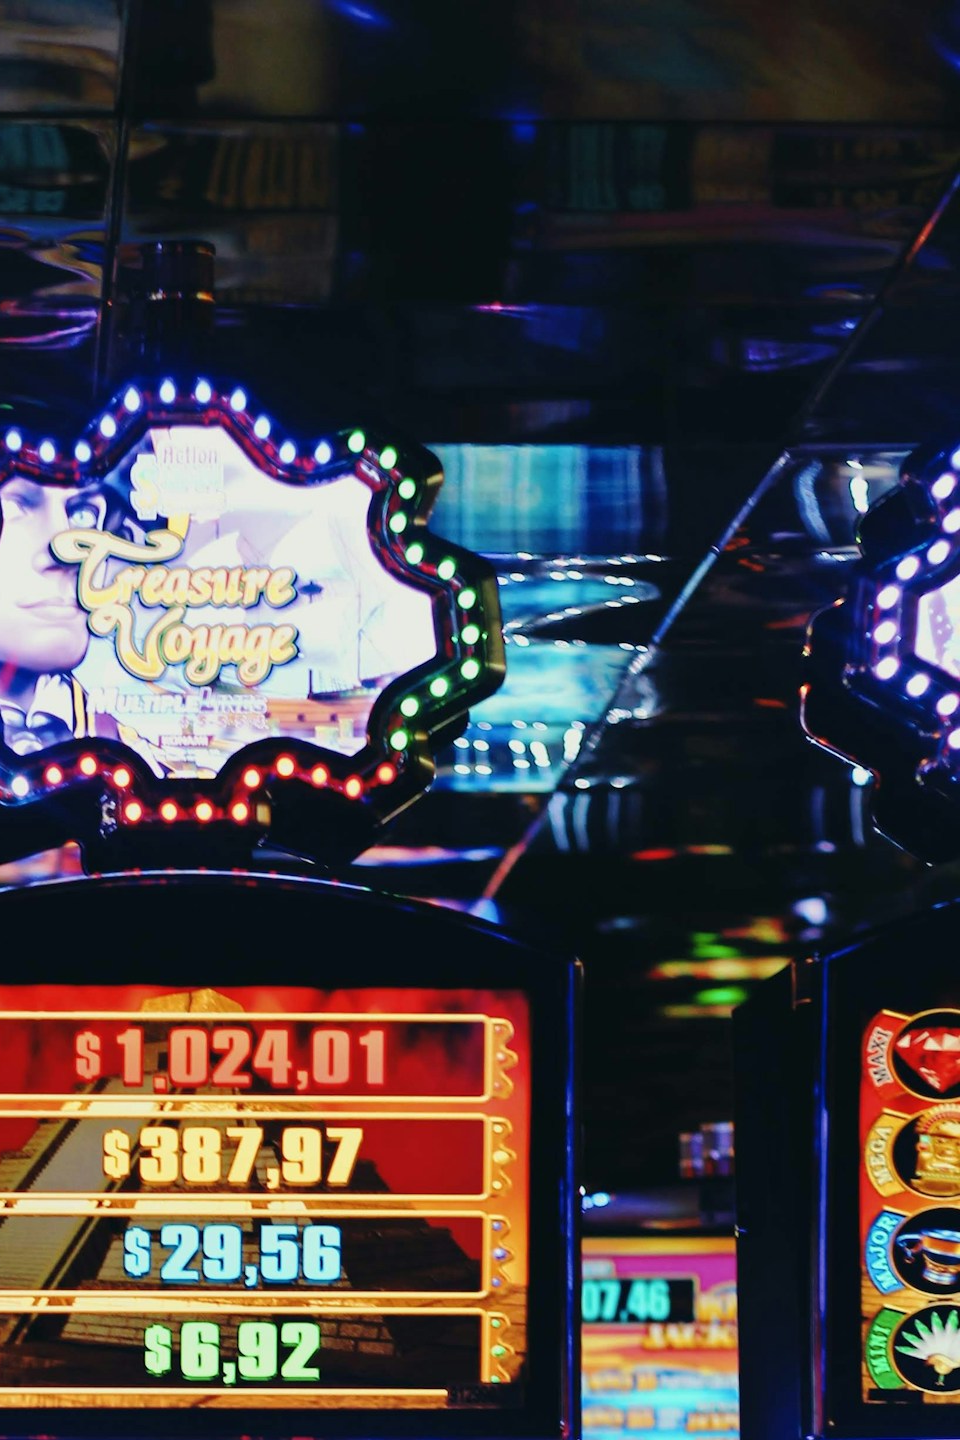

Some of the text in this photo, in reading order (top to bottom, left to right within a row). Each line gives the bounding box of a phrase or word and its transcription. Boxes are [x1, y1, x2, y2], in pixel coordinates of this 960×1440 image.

[50, 528, 298, 612] Treasure
[87, 602, 299, 686] Voyage
[866, 1025, 894, 1087] MAXI
[102, 1126, 364, 1190] $387,97
[865, 1123, 895, 1186] MEGA
[123, 1222, 343, 1287] $29,56
[867, 1211, 899, 1293] MAJOR
[142, 1319, 321, 1385] $6,92
[867, 1321, 892, 1379] MINI
